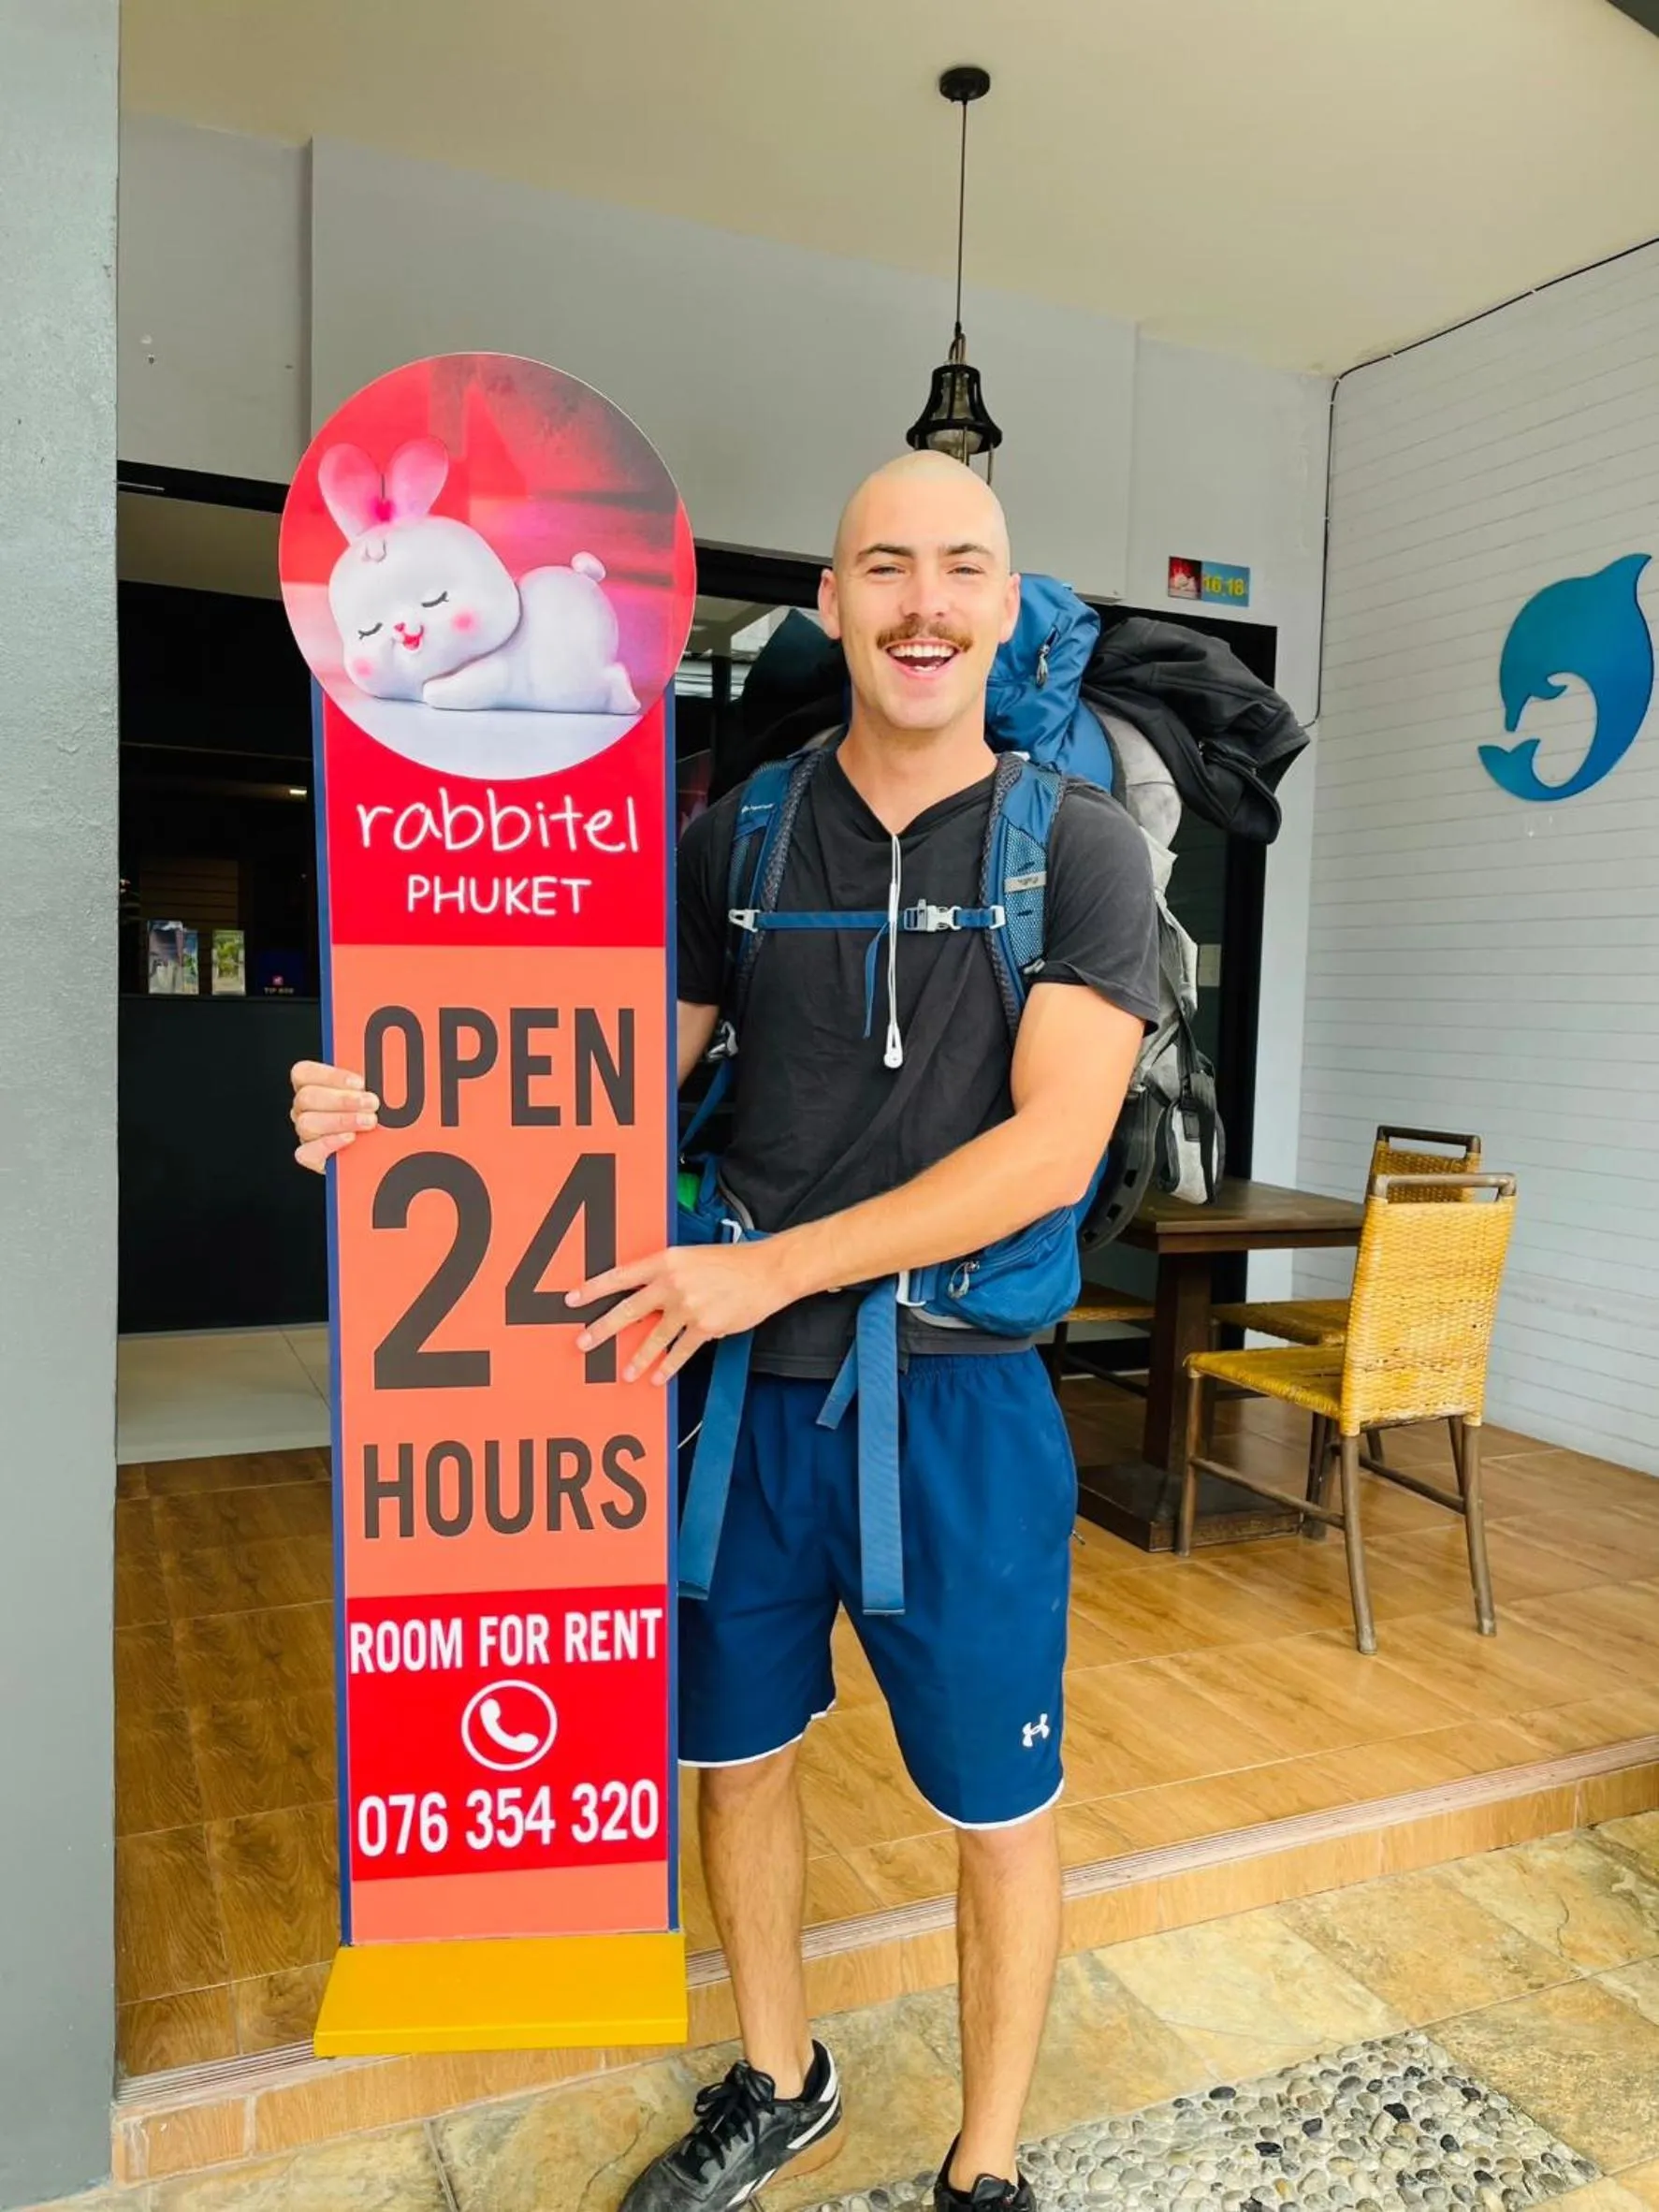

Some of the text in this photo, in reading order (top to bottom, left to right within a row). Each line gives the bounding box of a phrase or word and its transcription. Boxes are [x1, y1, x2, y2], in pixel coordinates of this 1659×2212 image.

[356, 787, 639, 852] rabbitel
[407, 874, 592, 915] PHUKET
[364, 1005, 634, 1128] OPEN
[372, 1151, 646, 1390] 24
[363, 1433, 648, 1539] HOURS
[350, 1608, 662, 1674] ROOM FOR RENT
[357, 1779, 659, 1856] 076 354 320
